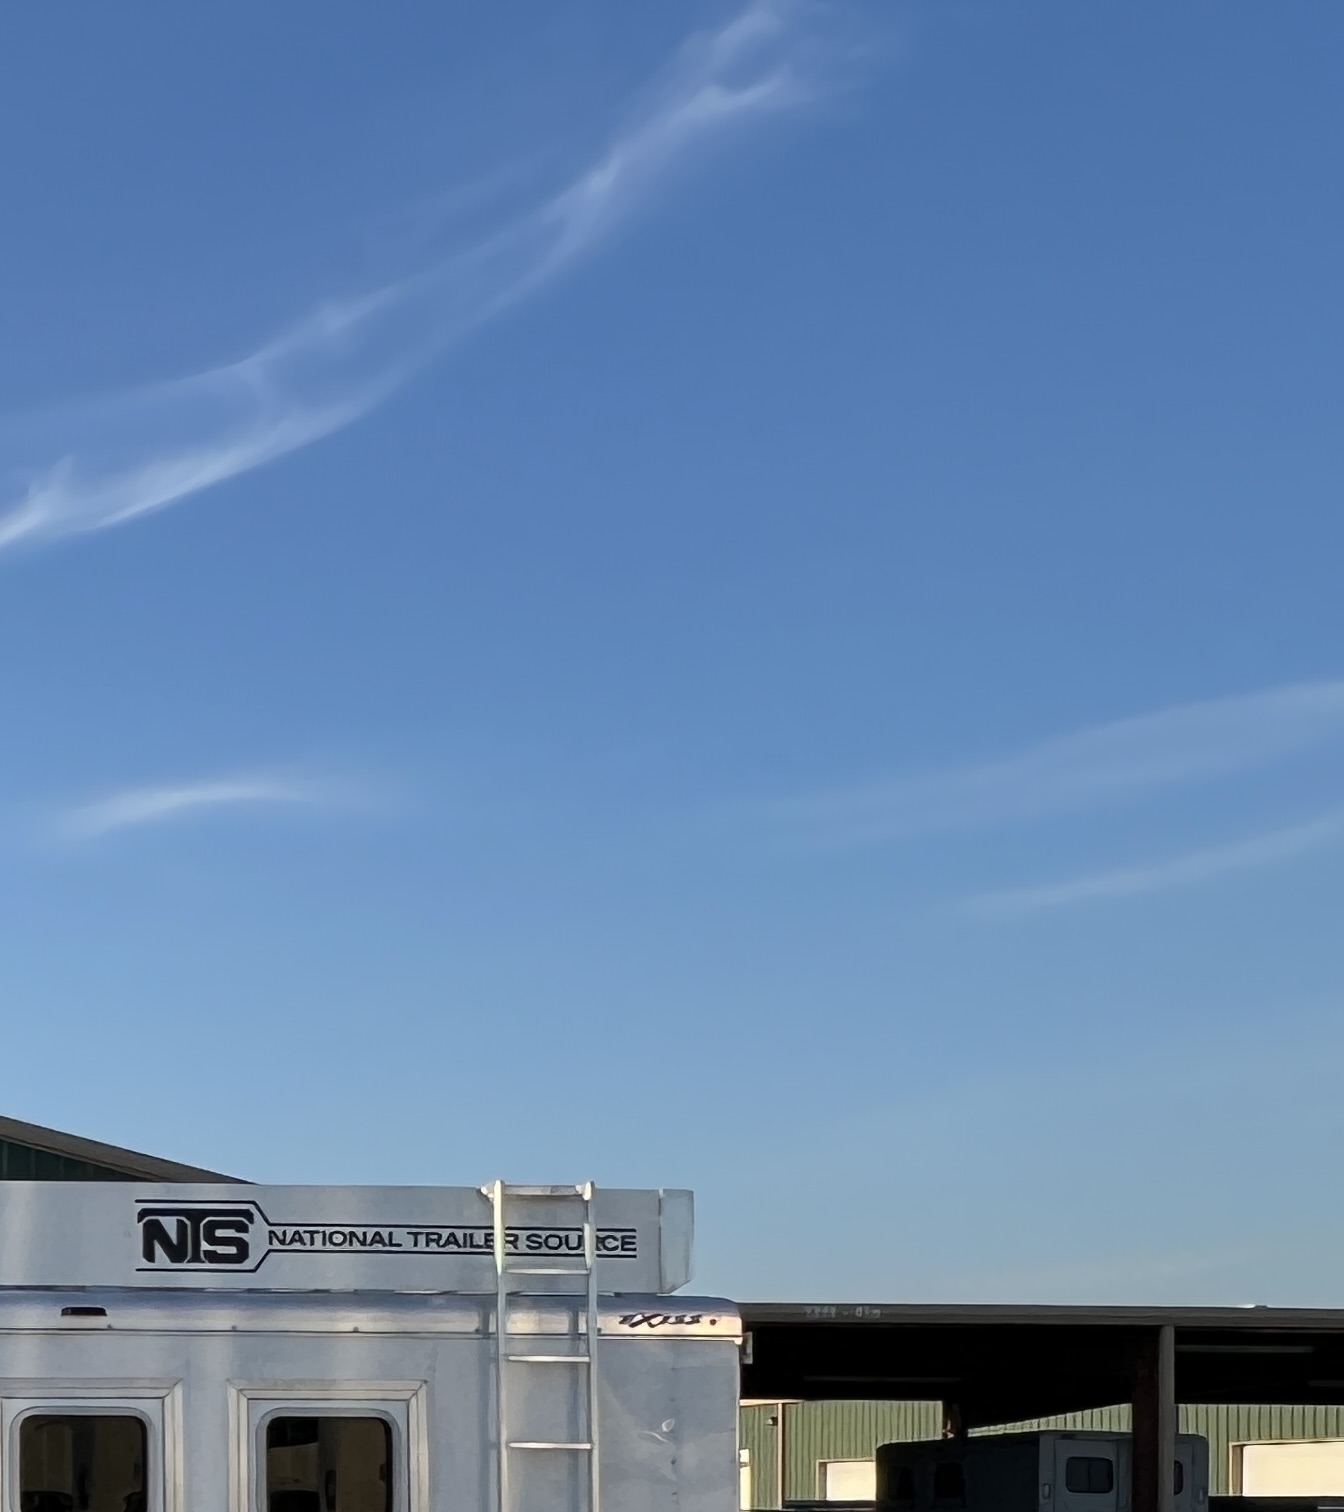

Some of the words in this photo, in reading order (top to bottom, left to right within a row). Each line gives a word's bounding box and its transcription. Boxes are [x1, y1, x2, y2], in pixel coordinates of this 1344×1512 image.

[137, 1207, 254, 1264] NTS
[268, 1229, 403, 1248] NATIONAL
[406, 1231, 520, 1250] TRAILER
